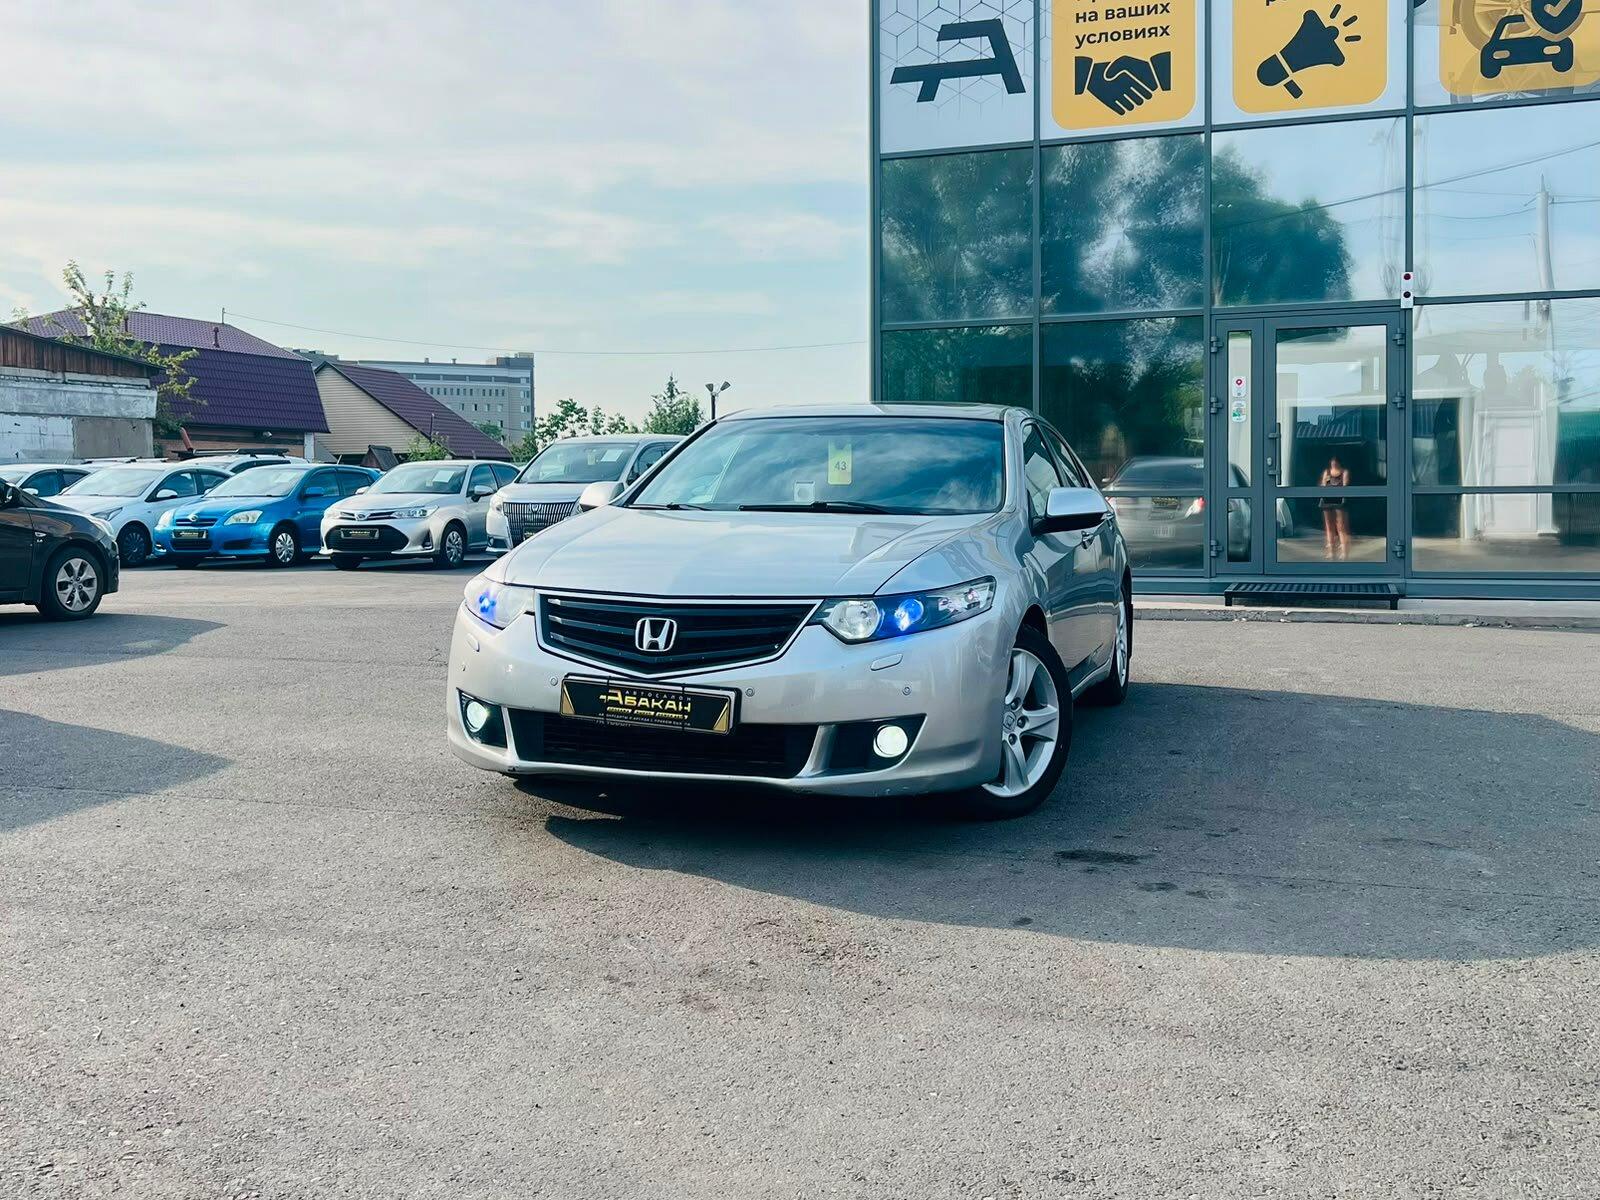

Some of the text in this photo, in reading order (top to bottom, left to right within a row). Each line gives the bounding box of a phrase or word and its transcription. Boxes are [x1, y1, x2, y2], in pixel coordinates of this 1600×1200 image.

[1075, 2, 1171, 23] на ваших
[1075, 25, 1171, 49] условиях
[834, 461, 847, 471] 43
[599, 689, 692, 713] АБАКАН
[625, 690, 692, 701] АВТОСАЛОН
